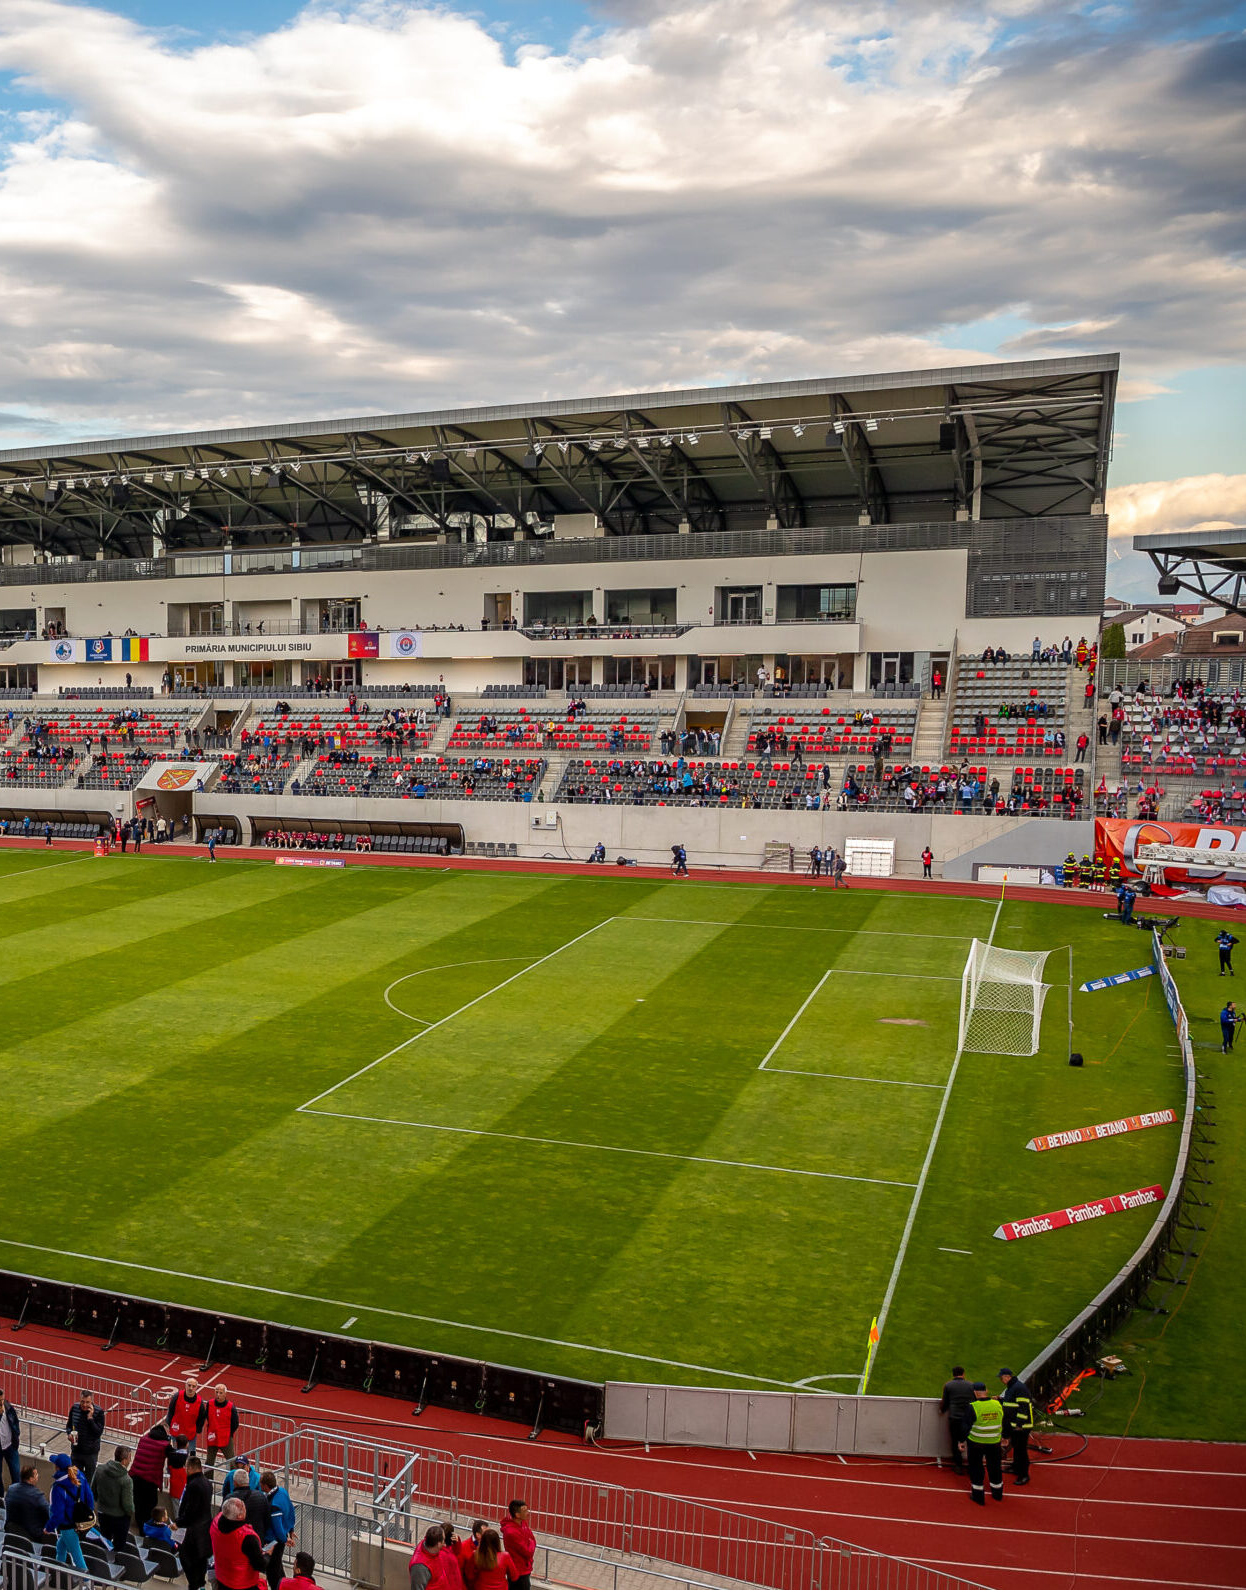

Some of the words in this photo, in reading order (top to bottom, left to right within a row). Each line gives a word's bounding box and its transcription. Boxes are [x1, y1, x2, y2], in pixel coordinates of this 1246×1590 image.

[185, 643, 226, 653] PRIMĂRIA
[228, 643, 286, 652] MUNICIPIULUI
[288, 643, 312, 651] SIBIU
[1047, 1130, 1082, 1148] BETANO
[1095, 1120, 1128, 1138] BETANO
[1140, 1110, 1173, 1126] BETANO
[1011, 1217, 1053, 1238] Pambac
[1066, 1203, 1106, 1224] Pambac
[1119, 1189, 1158, 1210] Pambac
